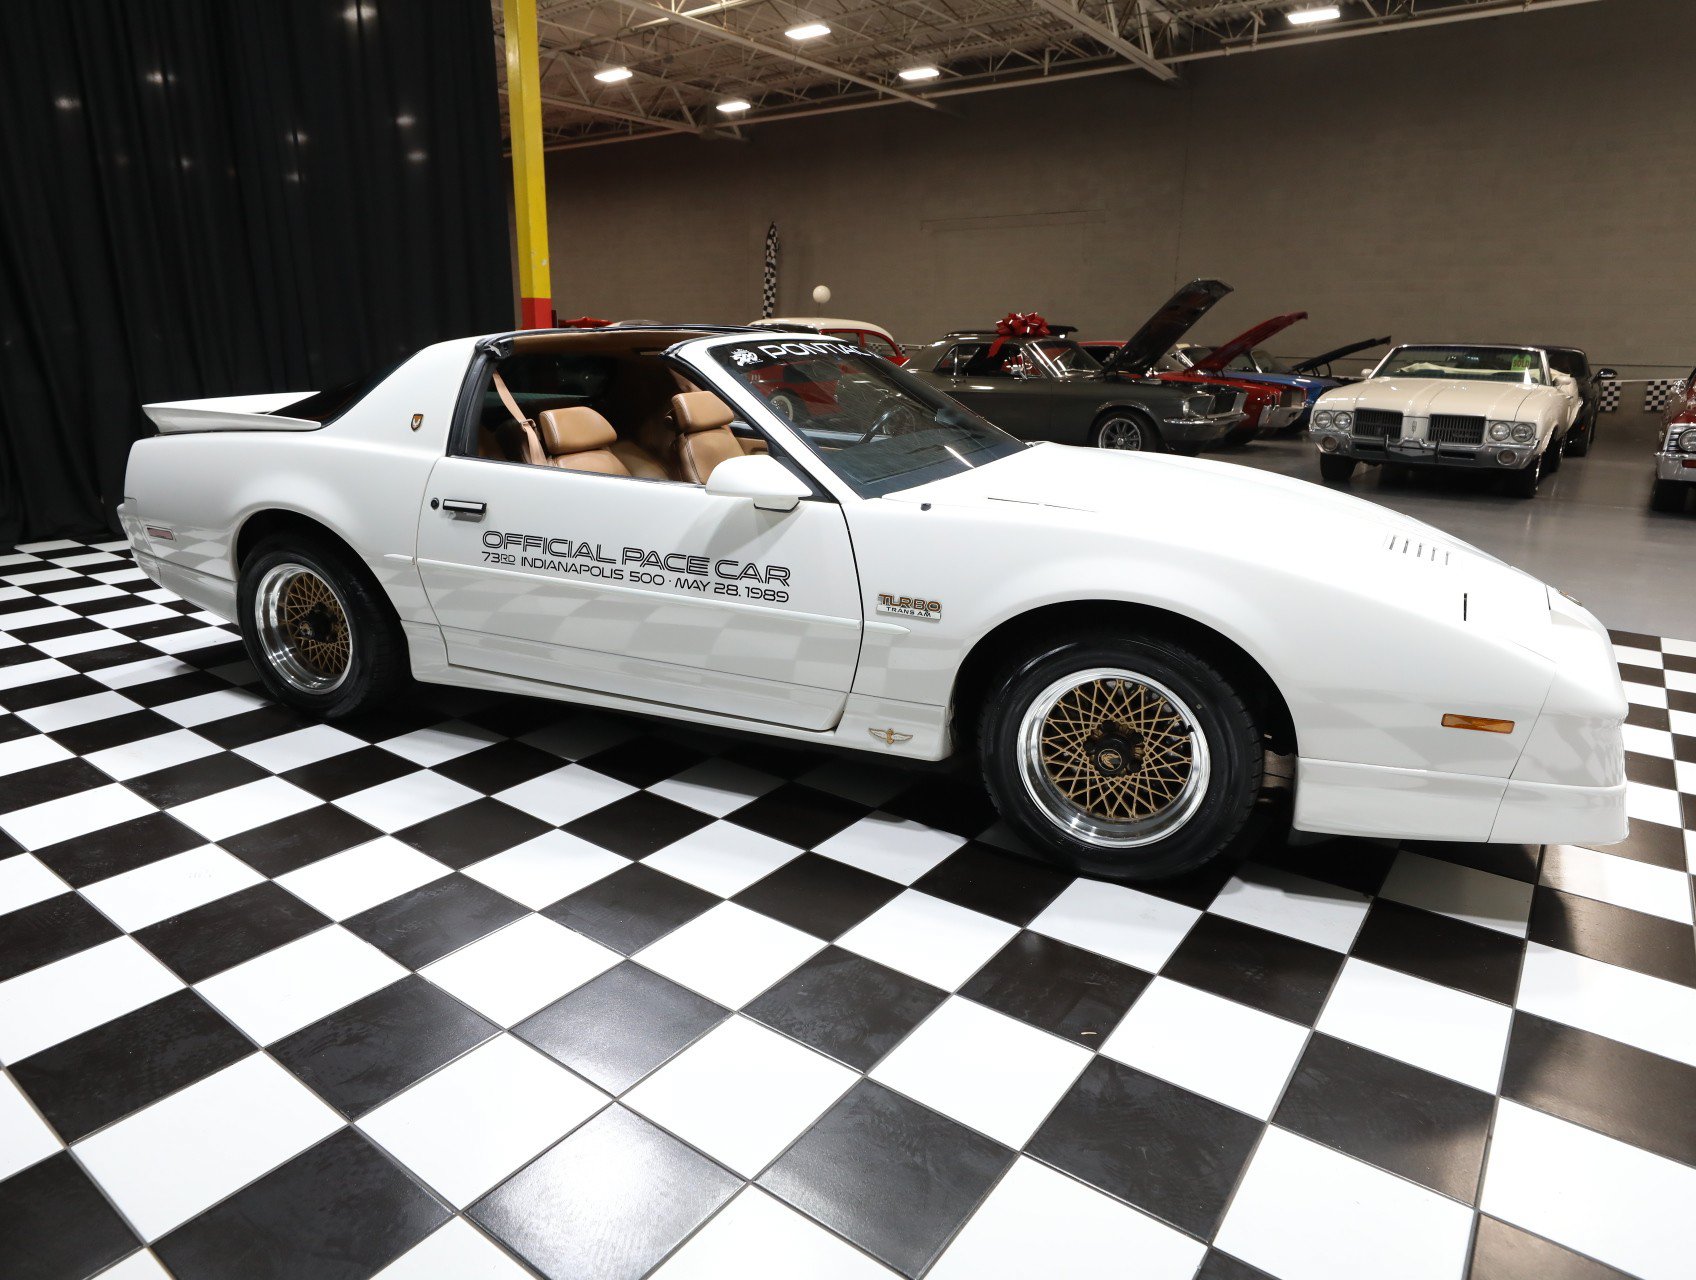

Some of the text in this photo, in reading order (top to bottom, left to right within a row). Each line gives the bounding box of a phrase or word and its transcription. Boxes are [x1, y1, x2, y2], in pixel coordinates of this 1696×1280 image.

[757, 342, 872, 359] PONTIAC
[482, 530, 791, 587] OFFICIAL PACE CAR
[481, 551, 516, 566] 73RD
[520, 556, 624, 580] INDIANAPOLIS
[629, 570, 665, 586] 500
[674, 577, 711, 592] MAY
[744, 586, 789, 603] 1989
[878, 593, 942, 613] TURBO
[886, 606, 932, 618] TRANS AM
